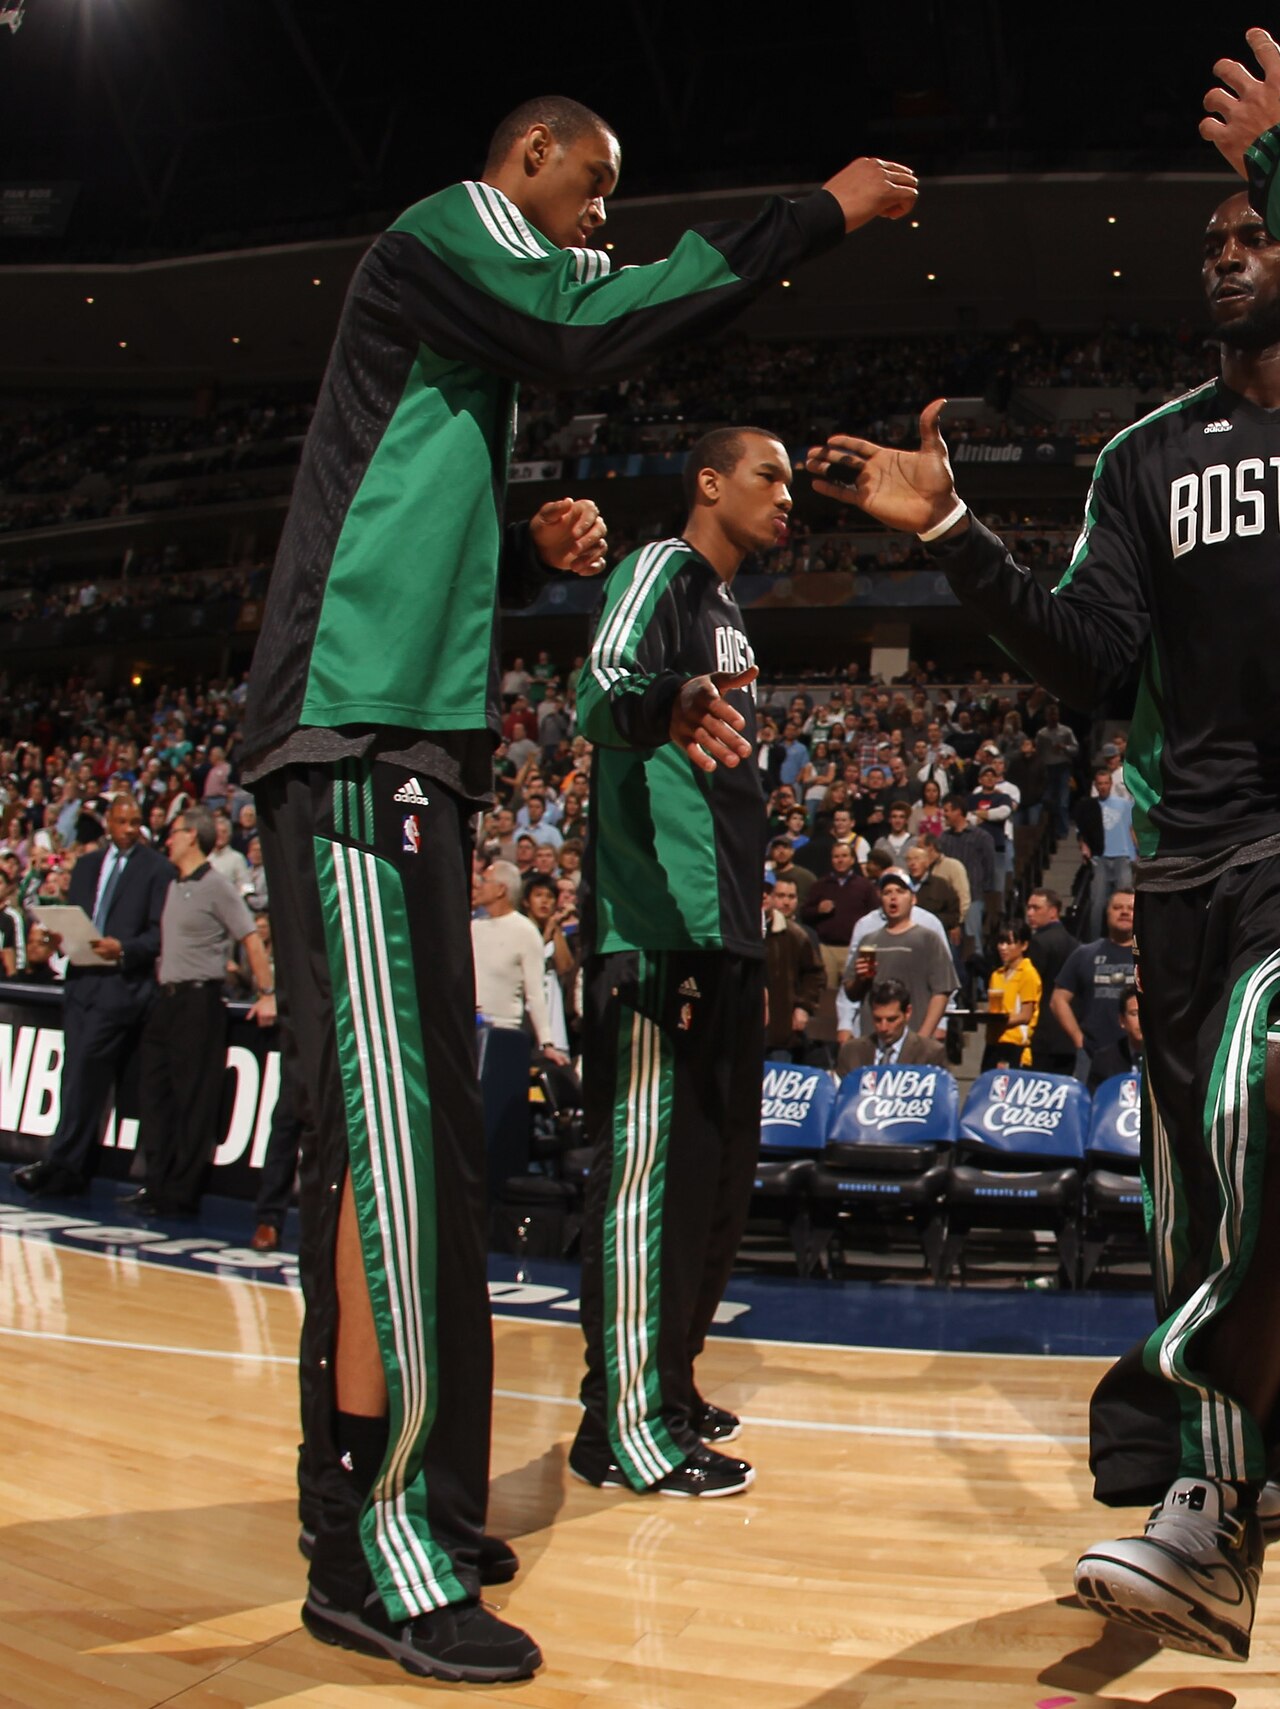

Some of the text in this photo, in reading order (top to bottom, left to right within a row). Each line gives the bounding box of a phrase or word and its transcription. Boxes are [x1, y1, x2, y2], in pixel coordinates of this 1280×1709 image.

[954, 443, 1023, 462] Altitude
[392, 793, 430, 806] adidas
[761, 1068, 820, 1101] NBA
[875, 1070, 937, 1098] NBA
[1005, 1077, 1070, 1111] NBA
[760, 1098, 811, 1121] ares
[856, 1095, 934, 1127] Cares
[982, 1103, 1063, 1132] Cares
